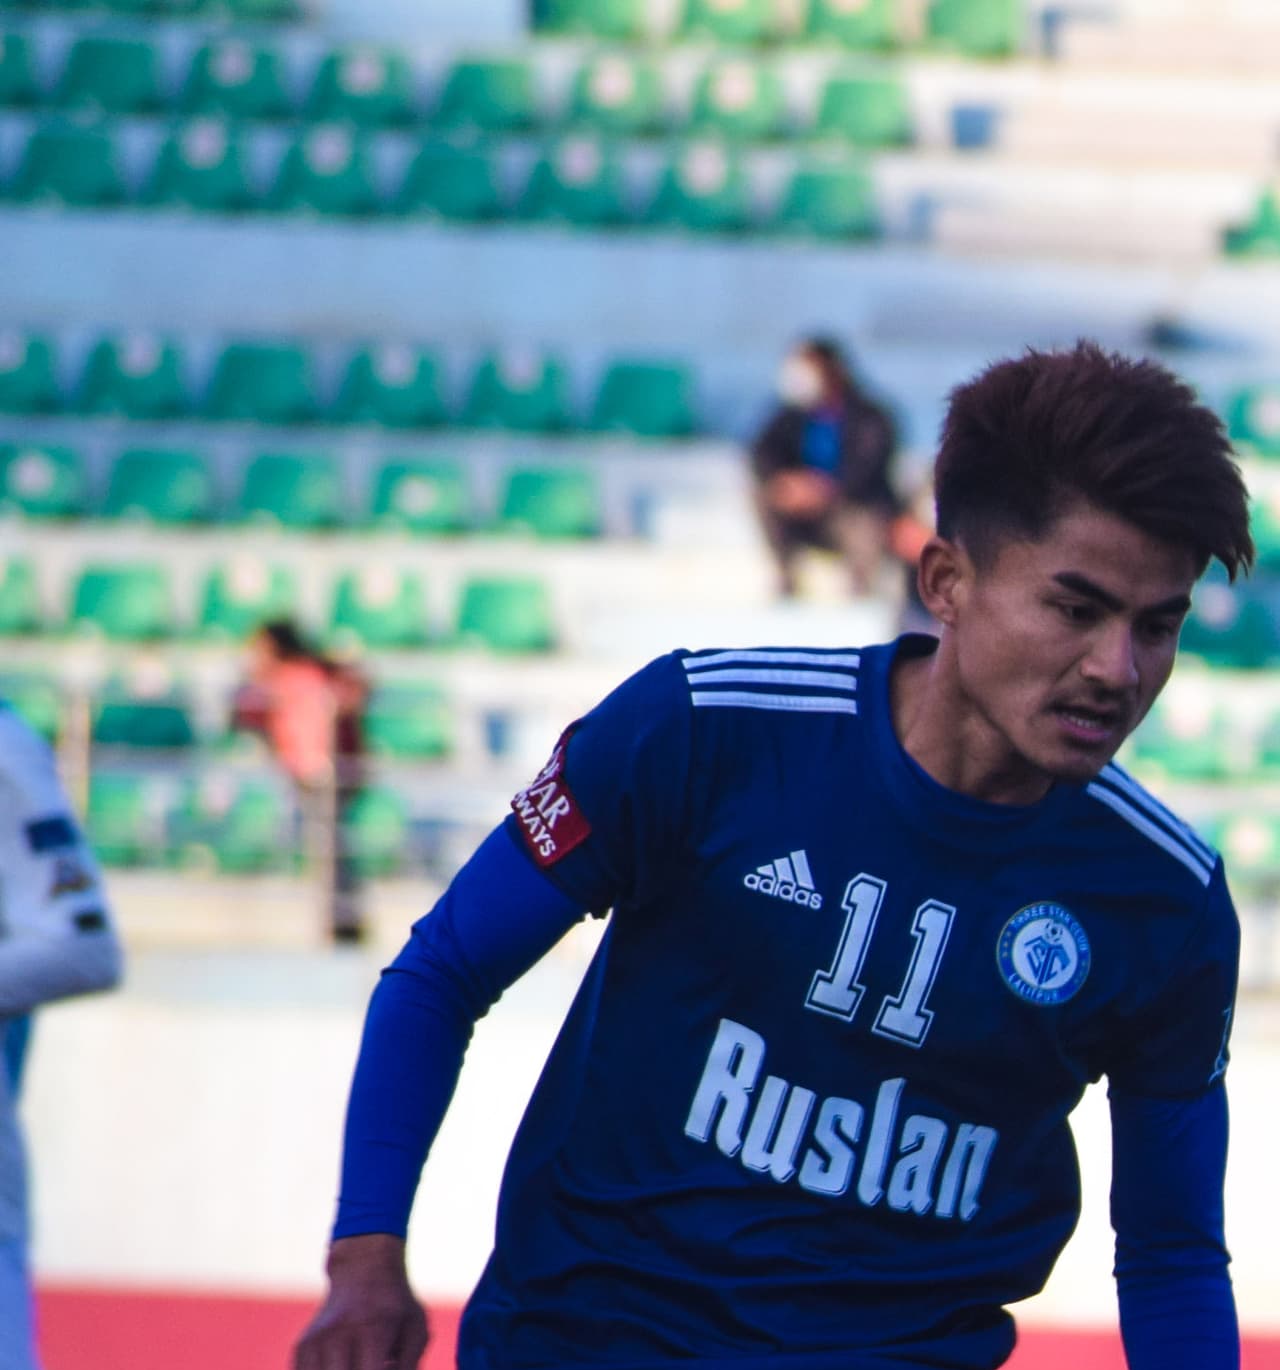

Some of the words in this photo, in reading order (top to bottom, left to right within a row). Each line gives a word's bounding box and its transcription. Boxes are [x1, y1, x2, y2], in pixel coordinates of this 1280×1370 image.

[743, 872, 823, 911] adidas
[804, 872, 957, 1049] 11
[684, 1017, 999, 1222] Ruslan
